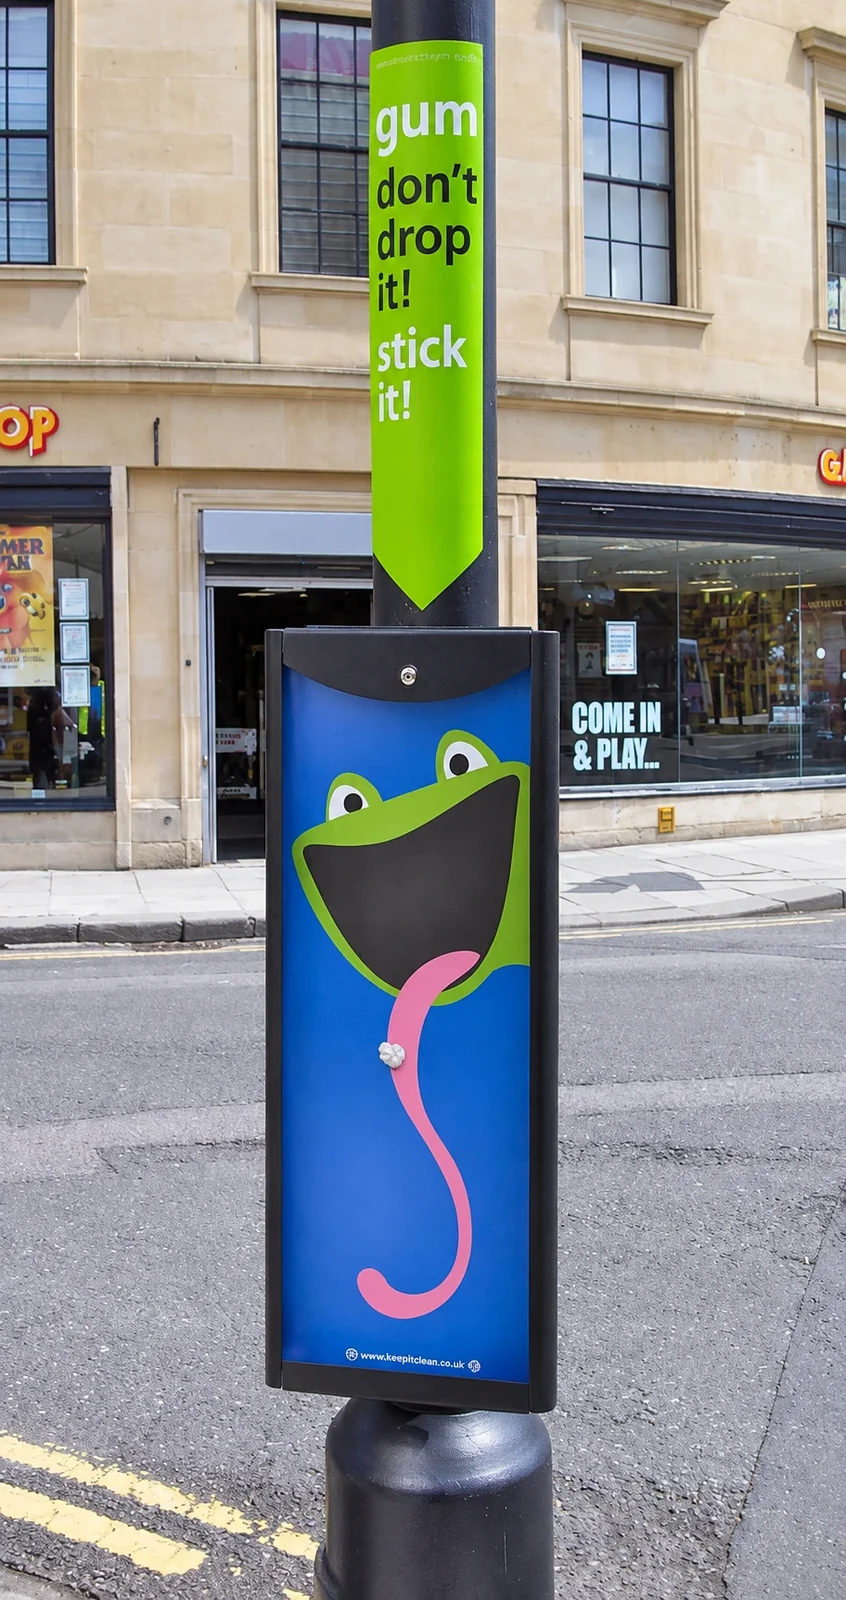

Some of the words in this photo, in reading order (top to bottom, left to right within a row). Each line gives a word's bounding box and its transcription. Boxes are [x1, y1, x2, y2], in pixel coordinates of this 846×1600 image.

[376, 101, 478, 157] gum
[377, 163, 478, 210] don’t
[377, 218, 471, 266] drop
[378, 269, 410, 311] it!
[377, 324, 468, 372] stick
[378, 380, 411, 422] it!
[0, 405, 59, 457] OP
[571, 701, 636, 735] COME
[639, 701, 662, 733] IN
[573, 739, 592, 771] &
[597, 737, 660, 770] PLAY...
[360, 1352, 465, 1369] www.keepitclean.co.uk
